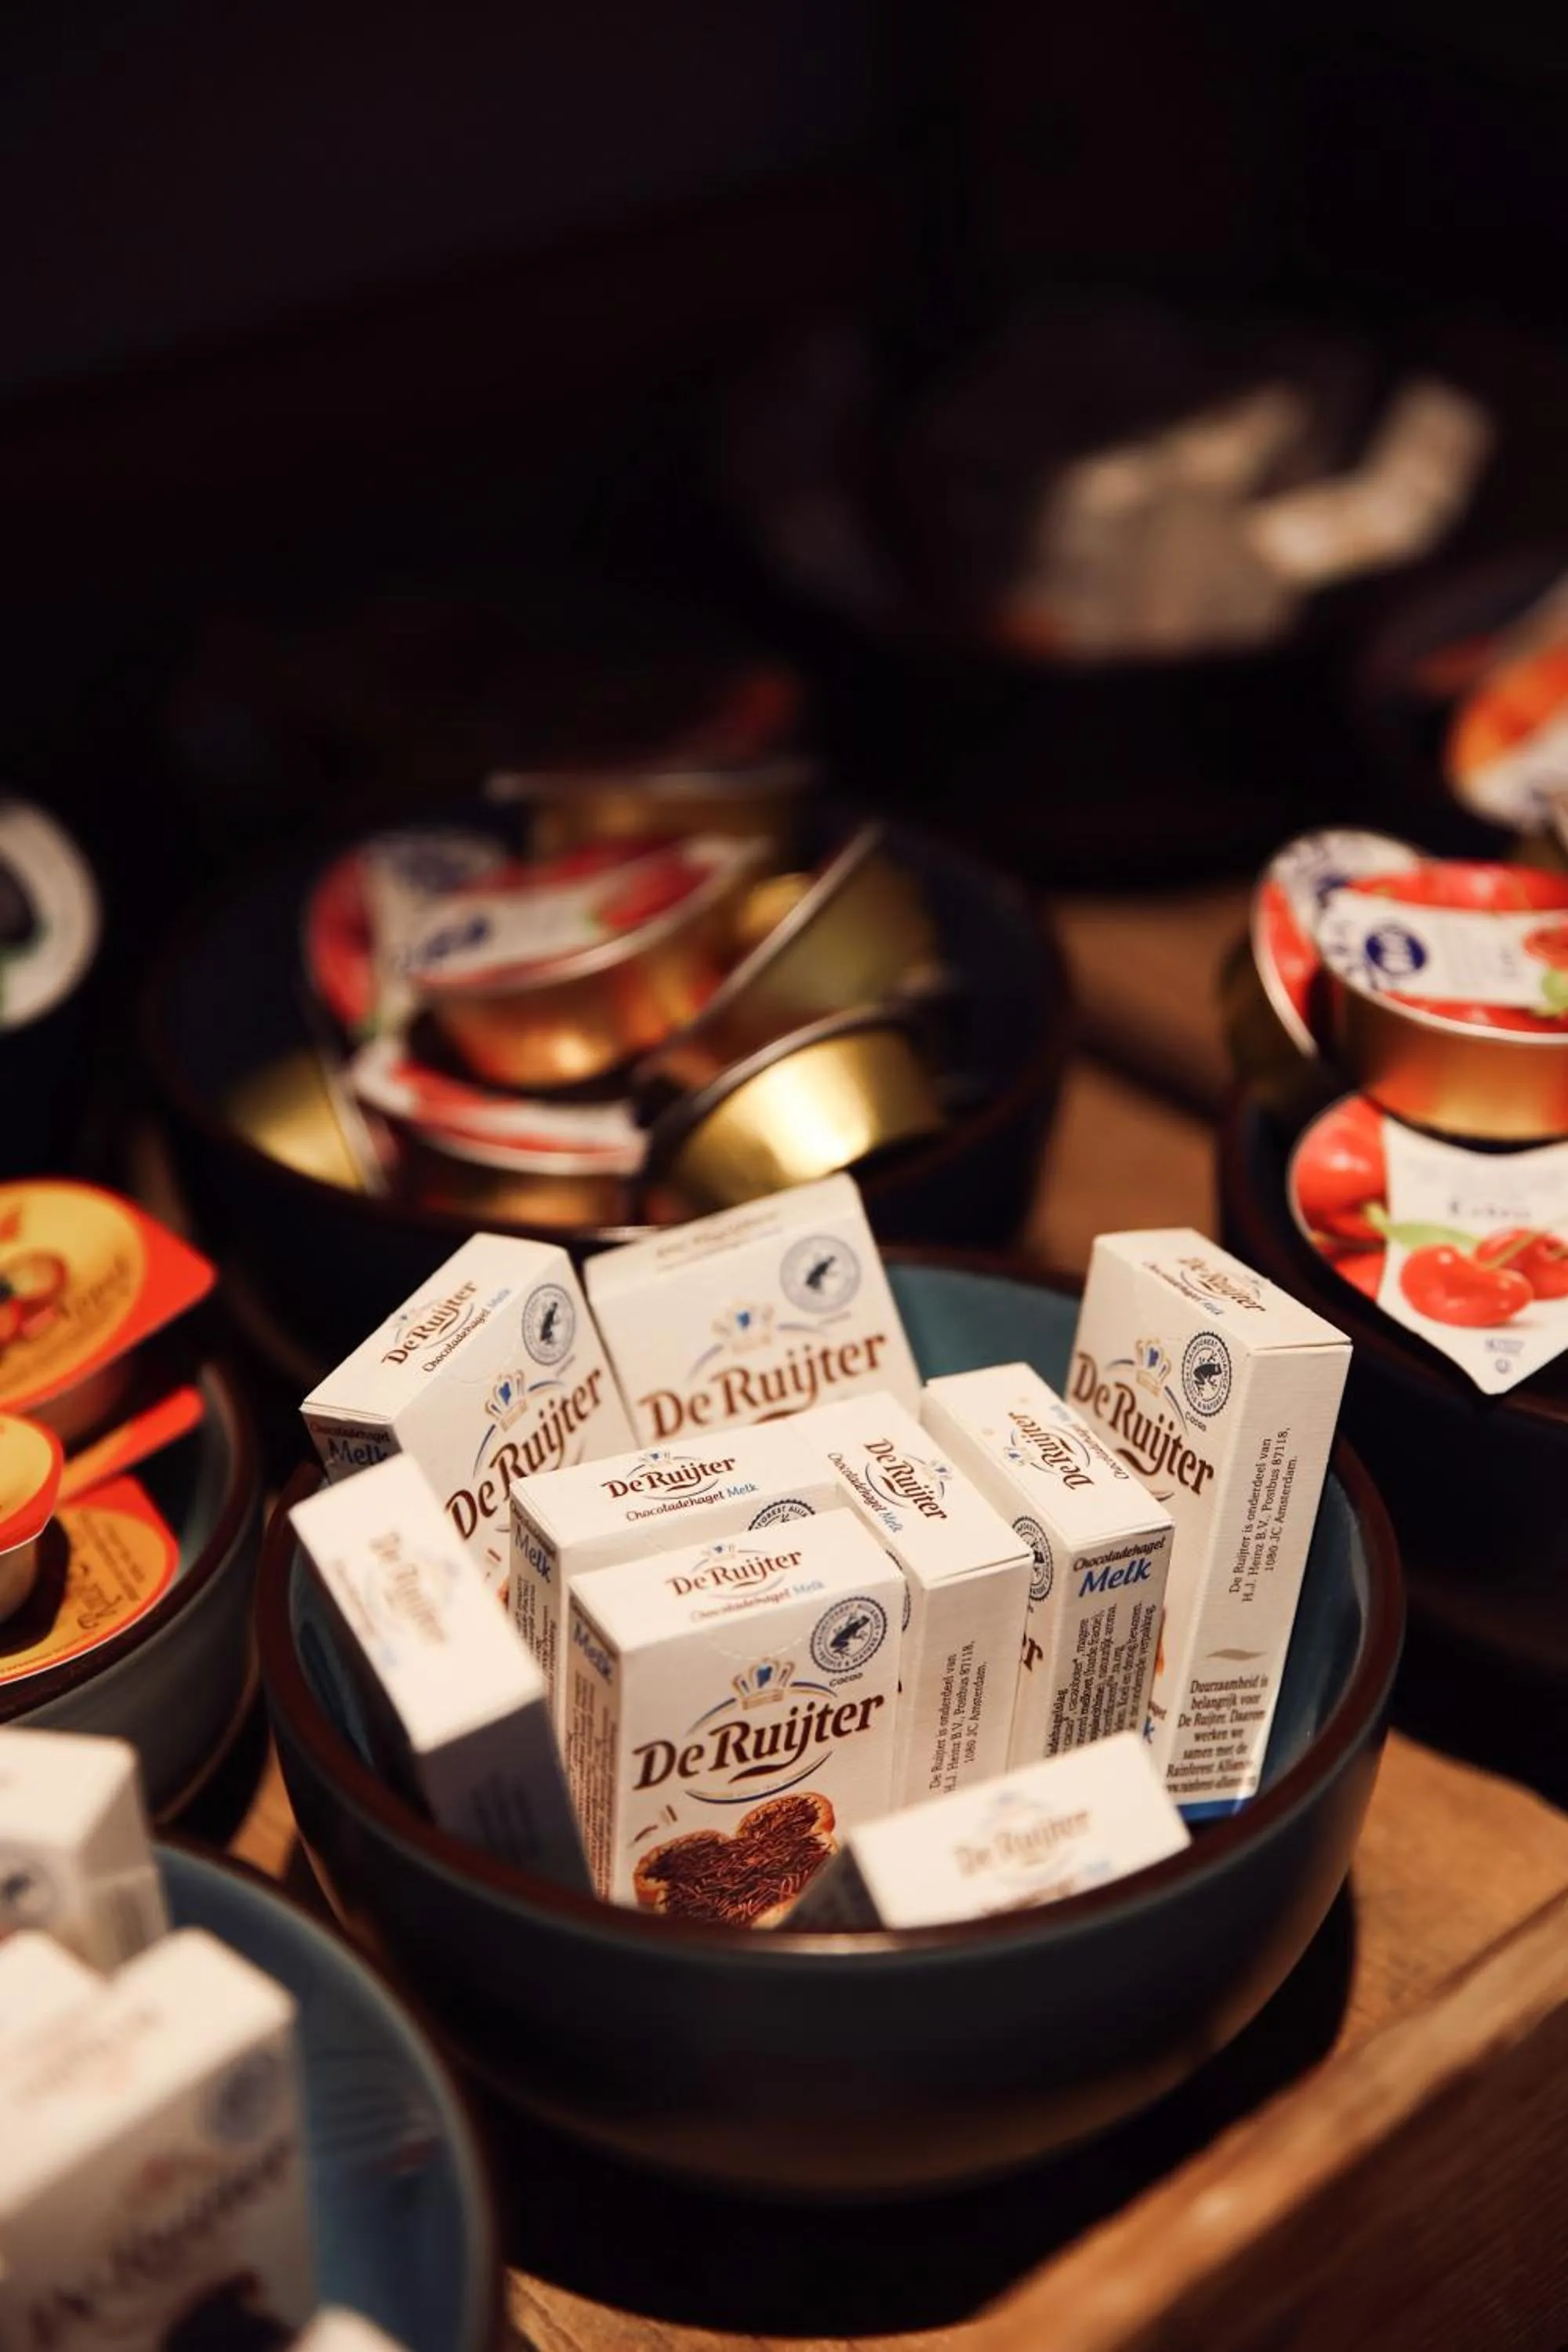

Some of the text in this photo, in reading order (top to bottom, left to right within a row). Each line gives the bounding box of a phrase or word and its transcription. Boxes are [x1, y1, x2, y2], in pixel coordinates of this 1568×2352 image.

[382, 1338, 417, 1366] De
[410, 1281, 477, 1342] Ruijter
[422, 1307, 492, 1372] Chocoladehagel
[638, 1334, 887, 1440] De Ruijter
[1008, 1412, 1075, 1468] Ruijter
[1072, 1352, 1214, 1495] De Ruijter
[445, 1480, 499, 1541] De
[489, 1368, 602, 1501] Ruijter
[601, 1457, 736, 1498] De Ruijter
[864, 1438, 947, 1521] De Ruijter
[1060, 1465, 1094, 1490] De
[626, 1483, 759, 1522] Chocoladehagel Melk
[827, 1452, 903, 1534] Chocoladehagel Melk
[1229, 1438, 1272, 1595] De Ruijter is onderdeel van
[1274, 1455, 1298, 1523] Amsterdam.
[1247, 1543, 1265, 1576] Heinz
[1261, 1468, 1280, 1513] Postbus
[1270, 1526, 1283, 1543] JC
[515, 1524, 551, 1584] Melk
[666, 1551, 803, 1597] De Ruijter
[1073, 1537, 1166, 1573] Chocoladehagel
[1078, 1556, 1152, 1599] Melk
[953, 1675, 970, 1716] Postbus
[1190, 1675, 1259, 1694] Duurzaamheid
[1191, 1693, 1237, 1711] belangrijk
[632, 1694, 884, 1791] De Ruijter
[1178, 1713, 1192, 1729] De
[1166, 1762, 1215, 1778] Rainforest
